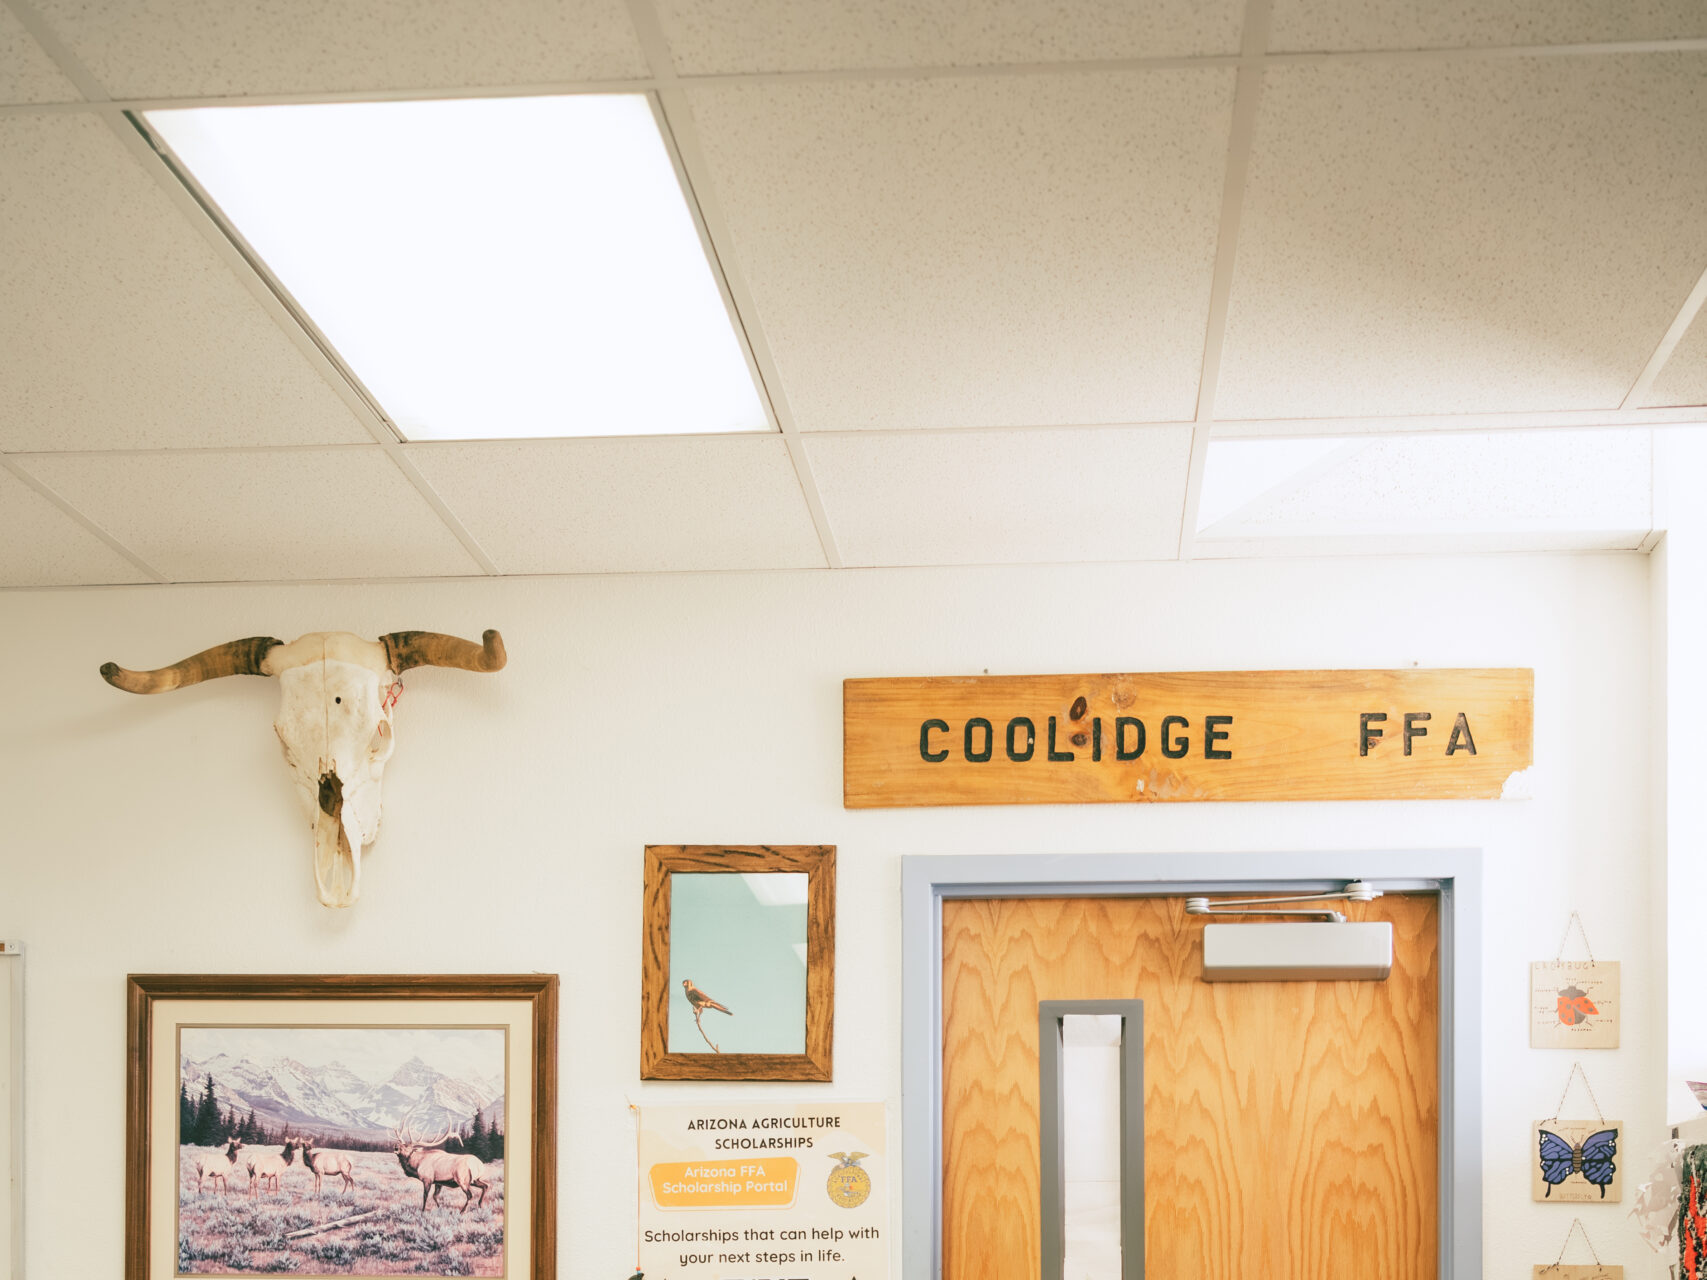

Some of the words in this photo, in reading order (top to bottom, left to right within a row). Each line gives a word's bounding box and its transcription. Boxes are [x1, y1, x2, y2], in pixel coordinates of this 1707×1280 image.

[919, 714, 1234, 763] COOLIDGE
[1359, 712, 1478, 757] FFA
[688, 1119, 747, 1130] ARIZONA
[752, 1116, 841, 1129] AGRICULTURE
[715, 1137, 814, 1150] SCHOLARSHIPS
[684, 1166, 736, 1178] Arizona
[740, 1165, 765, 1177] FFA
[662, 1181, 742, 1195] Scholarship
[746, 1180, 788, 1192] Portal
[644, 1229, 739, 1245] Scholarships
[744, 1228, 775, 1241] that
[780, 1230, 807, 1241] can
[812, 1227, 844, 1243] help
[848, 1226, 879, 1240] with
[679, 1252, 714, 1267] your
[719, 1251, 750, 1264] next
[755, 1251, 796, 1265] steps
[800, 1250, 813, 1263] in
[818, 1249, 845, 1262] life.
